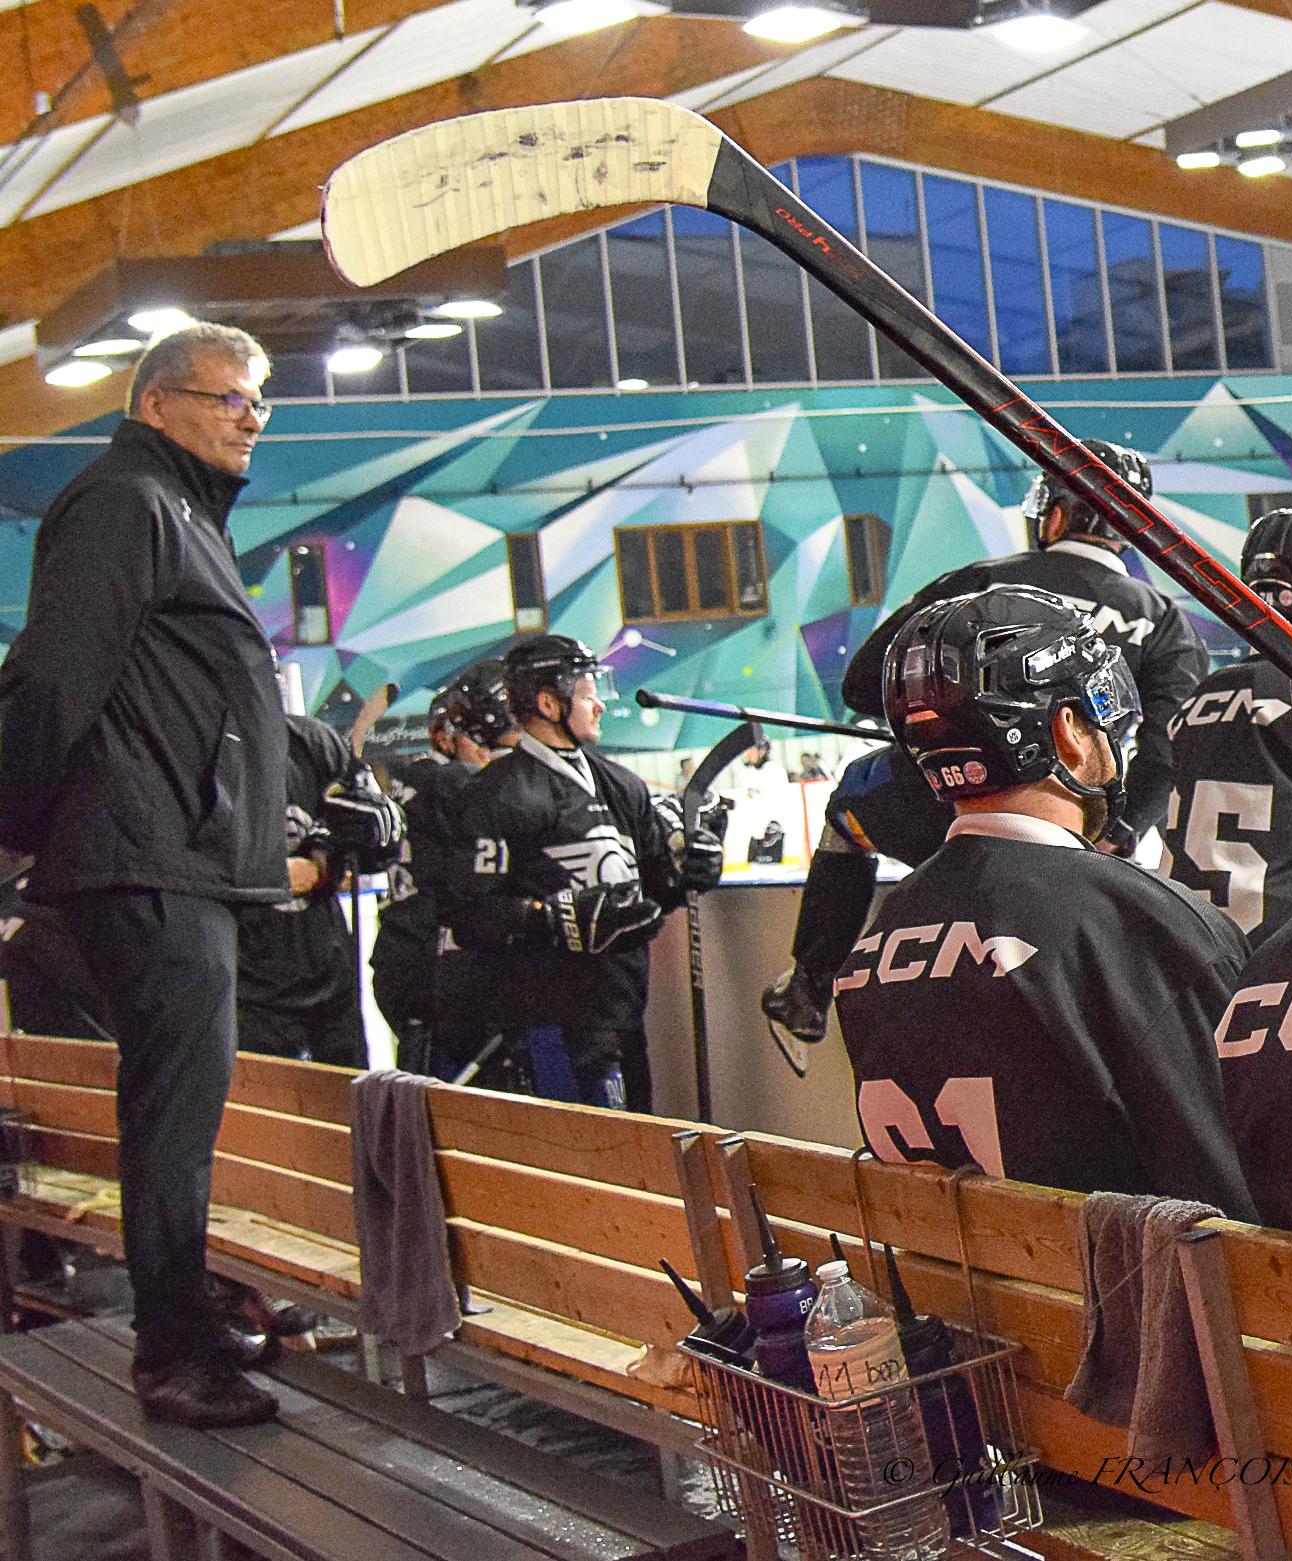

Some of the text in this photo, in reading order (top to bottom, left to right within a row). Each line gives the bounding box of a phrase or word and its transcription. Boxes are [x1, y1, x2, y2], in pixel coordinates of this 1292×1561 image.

[941, 766, 965, 787] 66
[473, 837, 511, 875] 21
[833, 921, 1038, 998] CCM
